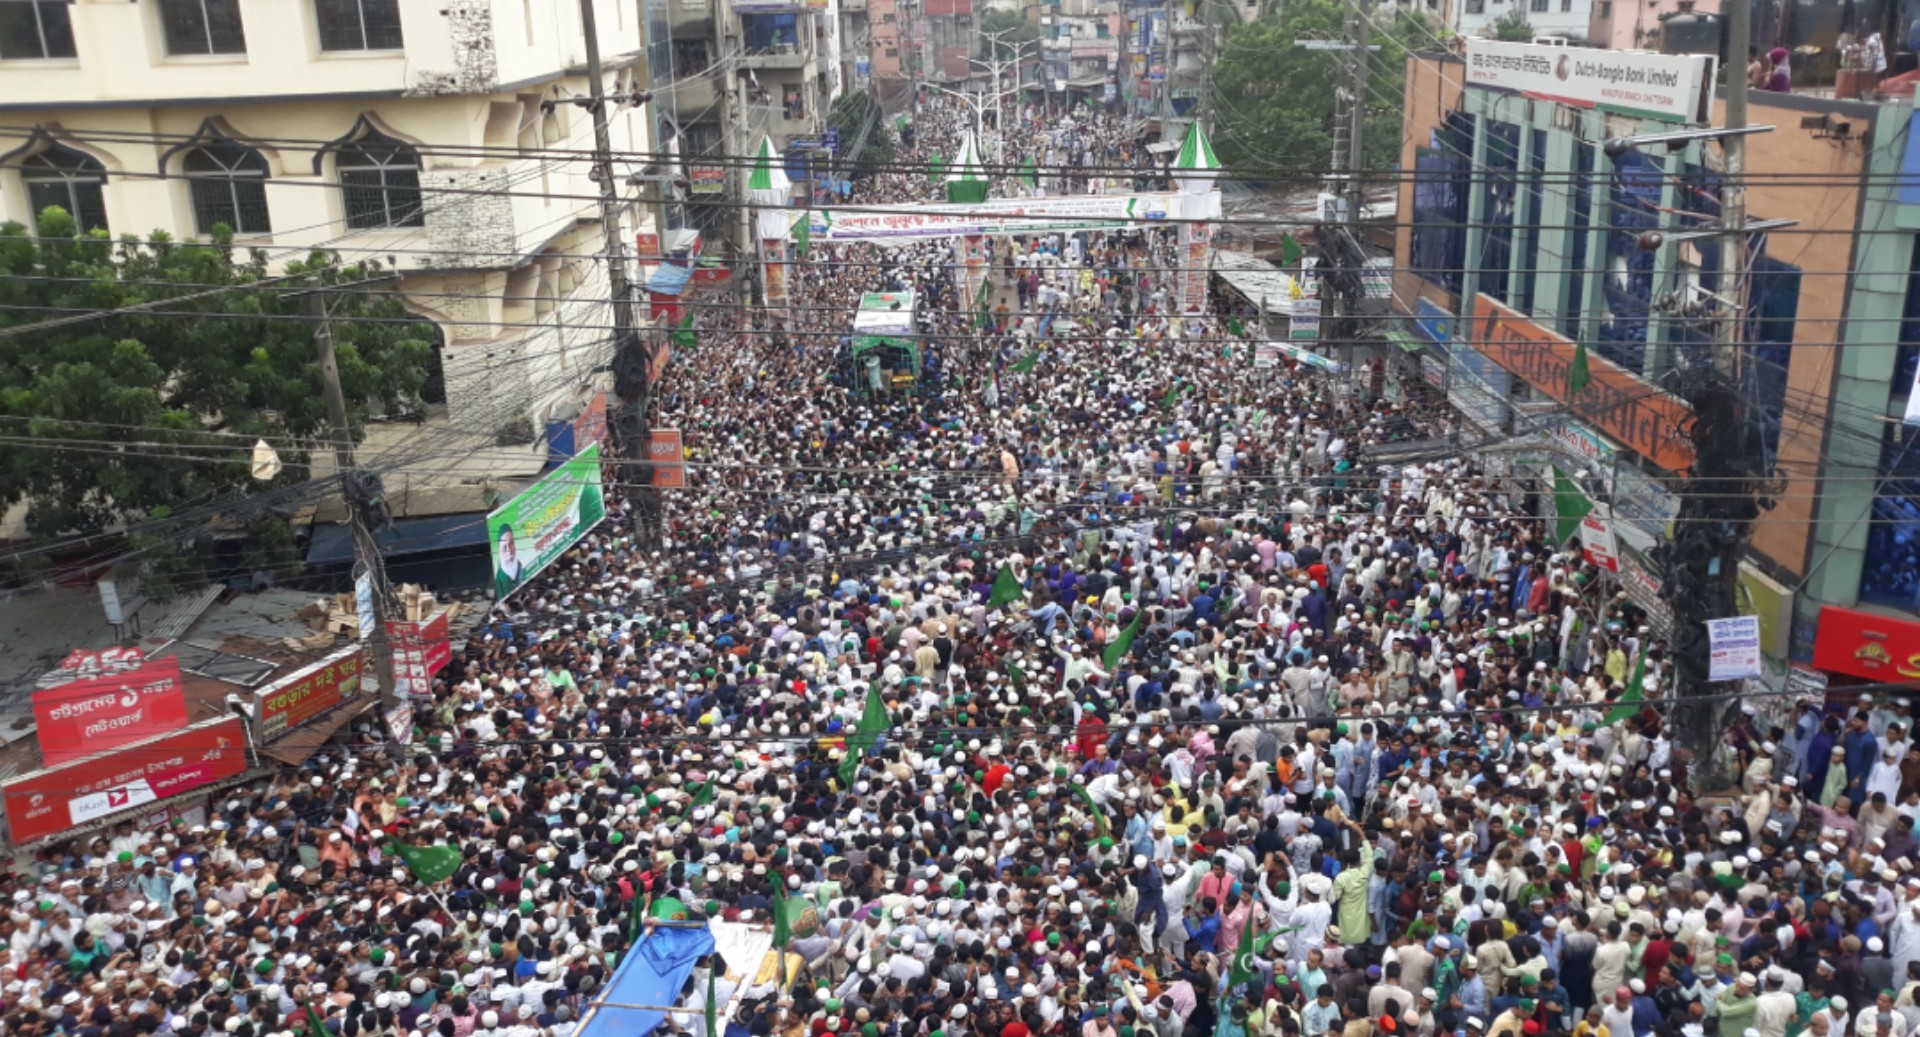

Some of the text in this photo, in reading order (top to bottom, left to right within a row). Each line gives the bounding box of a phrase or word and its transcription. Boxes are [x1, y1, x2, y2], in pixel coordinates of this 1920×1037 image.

[1574, 60, 1679, 87] Dutch-Bangla Bank Limited
[266, 659, 357, 711] বগুড়ার দই ঘর
[49, 693, 117, 720] চট্টগ্রামের
[120, 684, 139, 708] ১
[84, 708, 144, 738] নেটওয়ার্ক
